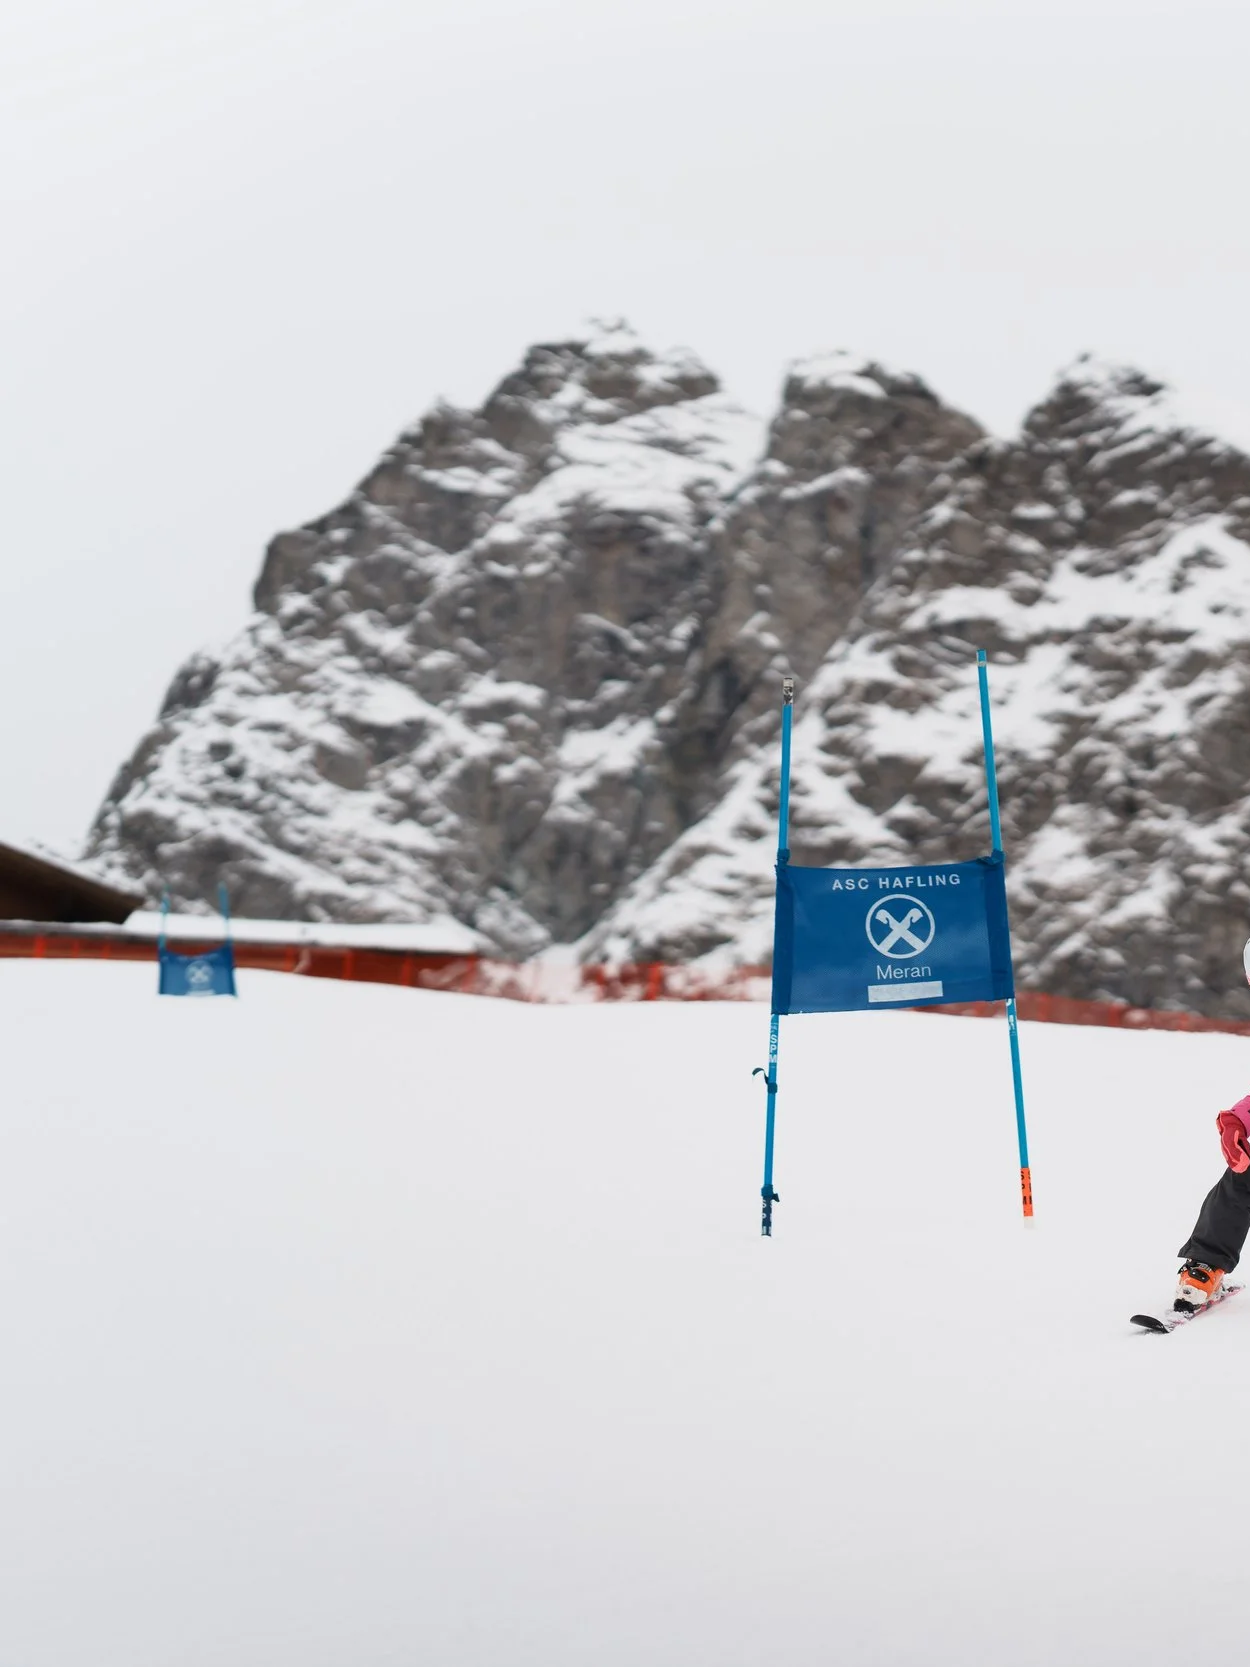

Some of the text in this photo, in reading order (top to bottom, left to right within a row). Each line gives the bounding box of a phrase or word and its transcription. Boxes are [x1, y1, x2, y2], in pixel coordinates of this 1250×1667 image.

[832, 873, 961, 891] ASC HAFLING
[876, 964, 932, 980] Meran
